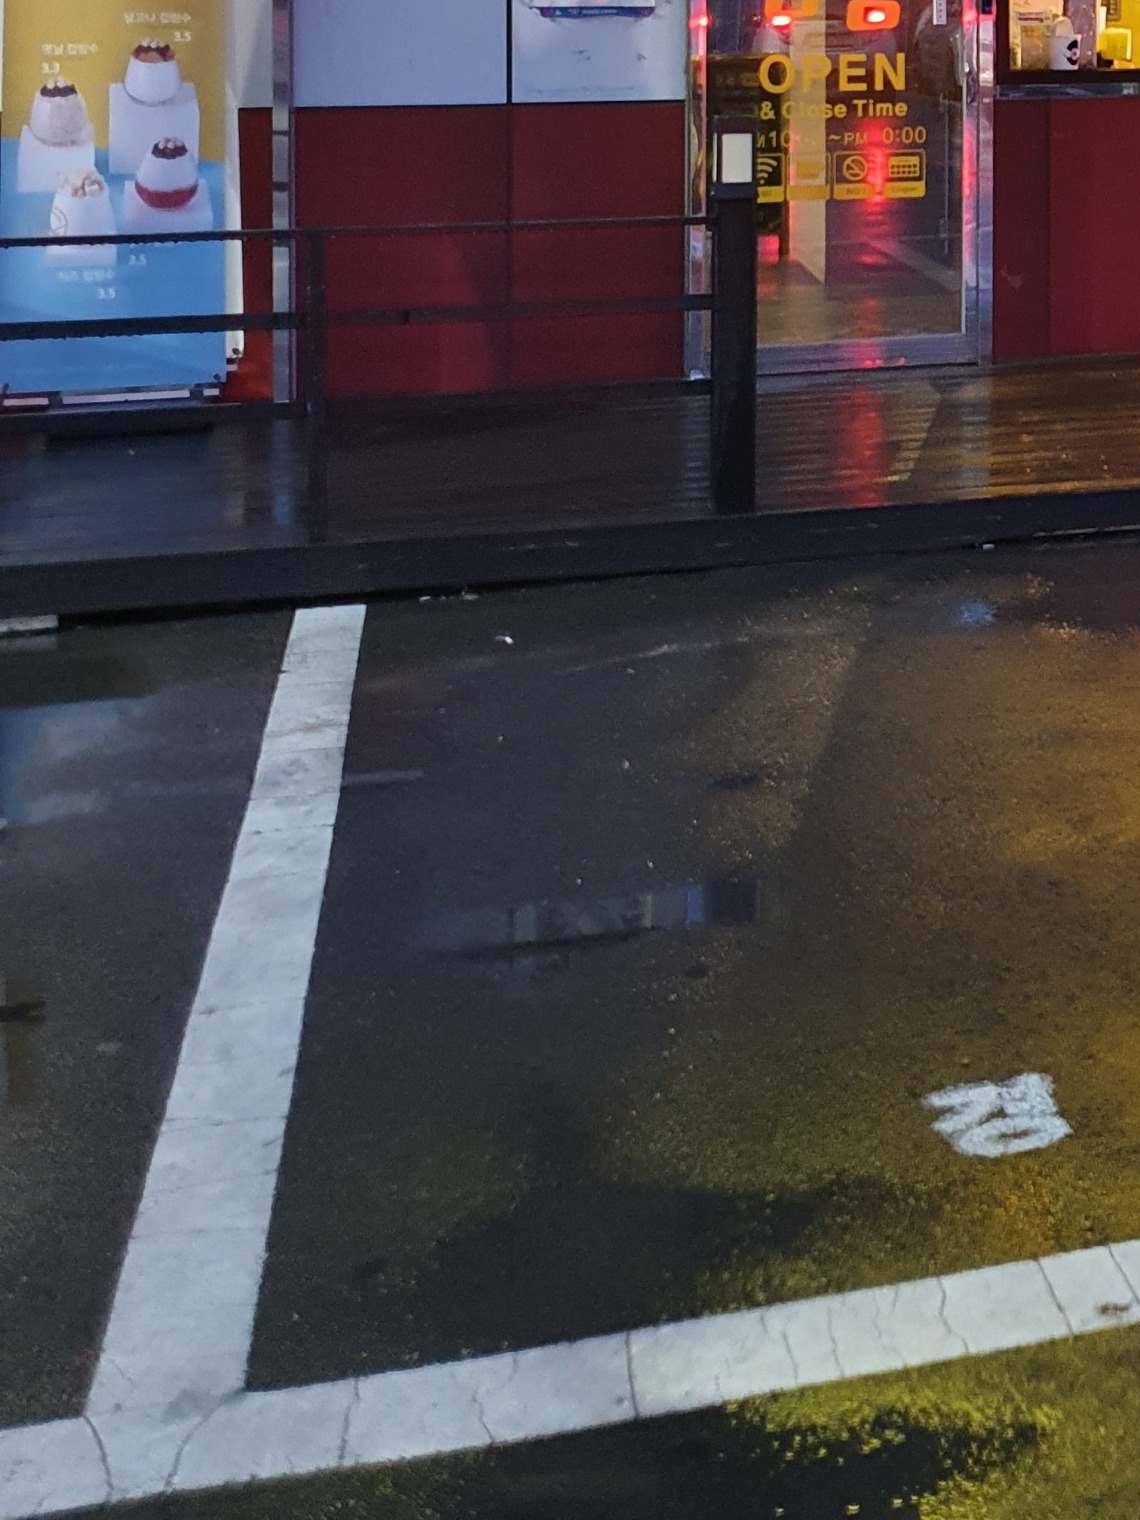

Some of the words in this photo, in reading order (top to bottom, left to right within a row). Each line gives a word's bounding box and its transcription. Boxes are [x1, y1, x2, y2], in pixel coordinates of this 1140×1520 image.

[758, 52, 906, 94] OPEN
[759, 101, 776, 120] &
[852, 99, 908, 117] Time
